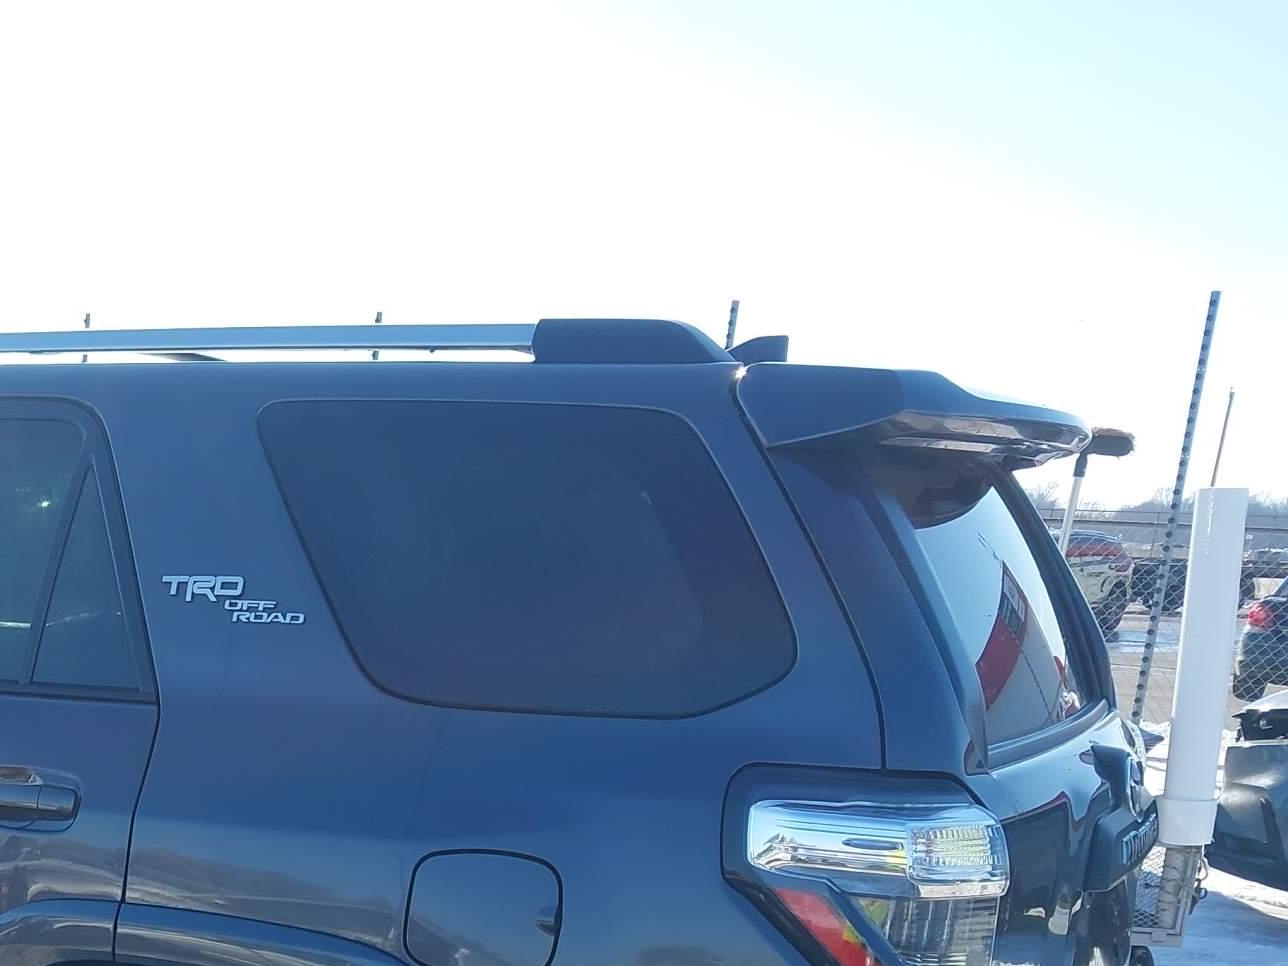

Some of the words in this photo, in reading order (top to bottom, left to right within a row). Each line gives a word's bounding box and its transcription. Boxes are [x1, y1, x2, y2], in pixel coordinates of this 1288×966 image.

[161, 575, 245, 602] TRD
[224, 599, 278, 611] OFF
[231, 611, 305, 625] ROAD
